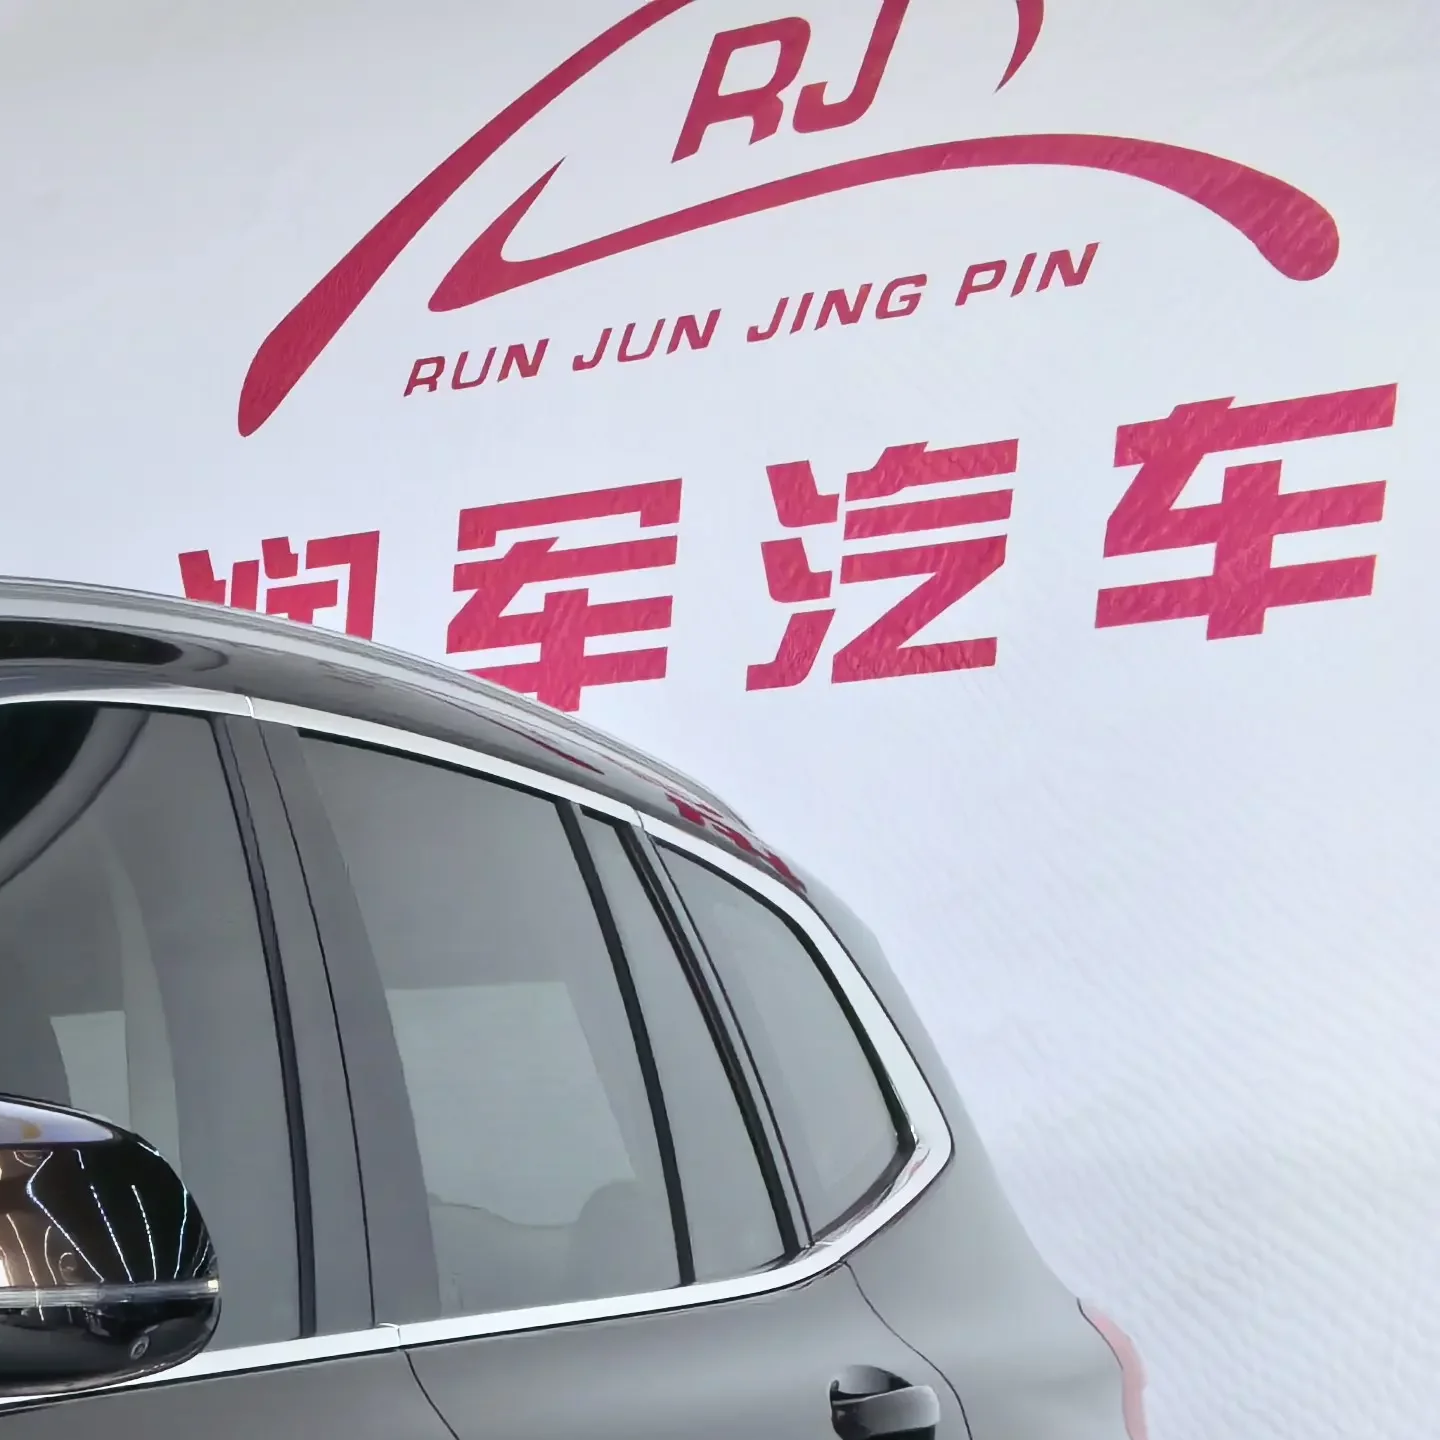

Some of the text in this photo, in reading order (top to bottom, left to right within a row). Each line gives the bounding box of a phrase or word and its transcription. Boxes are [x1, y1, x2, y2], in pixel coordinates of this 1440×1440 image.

[672, 0, 904, 163] RJ
[403, 242, 1100, 397] RUN JUN JING PIN
